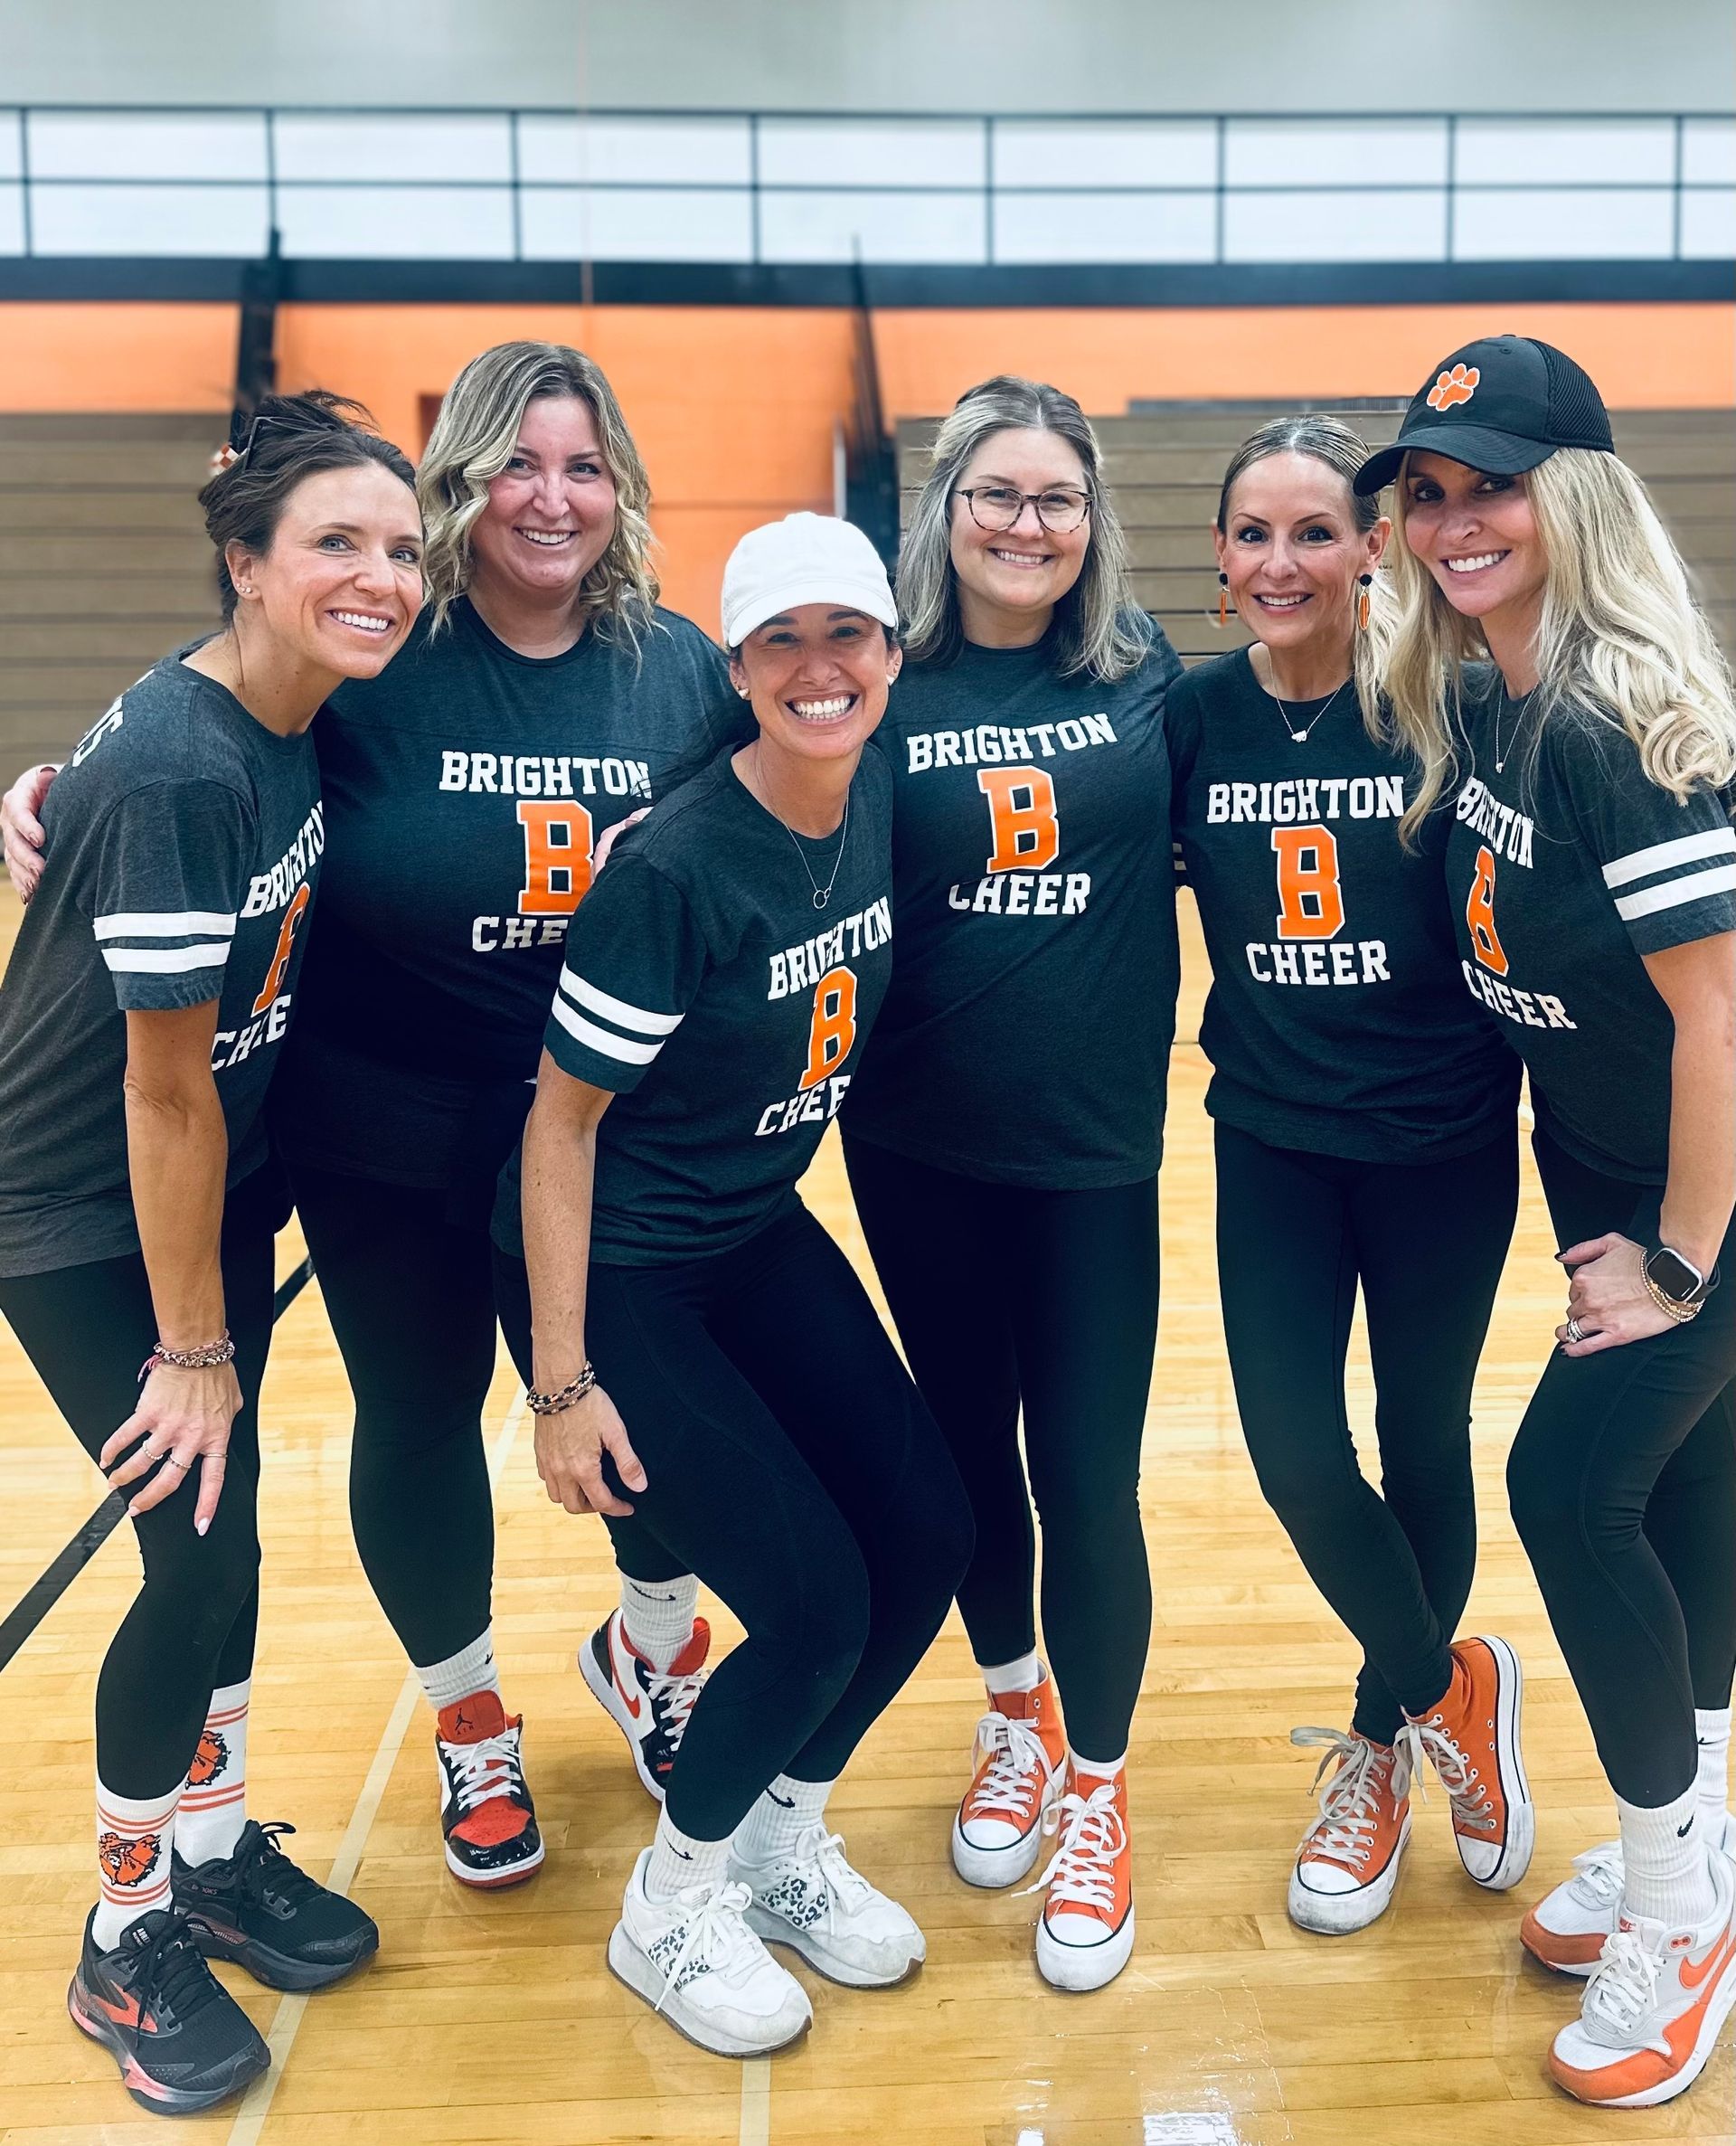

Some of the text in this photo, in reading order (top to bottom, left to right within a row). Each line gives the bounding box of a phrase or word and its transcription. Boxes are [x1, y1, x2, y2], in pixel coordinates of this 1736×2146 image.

[439, 751, 652, 799] BRIGHTON
[907, 713, 1118, 774] BRIGHTON
[976, 765, 1060, 874] B
[1207, 776, 1404, 825] BRIGHTON
[240, 799, 325, 918] BRIGHTO
[516, 799, 593, 915] B
[949, 873, 1090, 915] CHEER
[1270, 824, 1345, 941] B
[768, 895, 892, 1000] BRIGHTON
[1246, 940, 1391, 986] CHEER
[797, 965, 857, 1091] B
[1461, 960, 1578, 1030] CHEER
